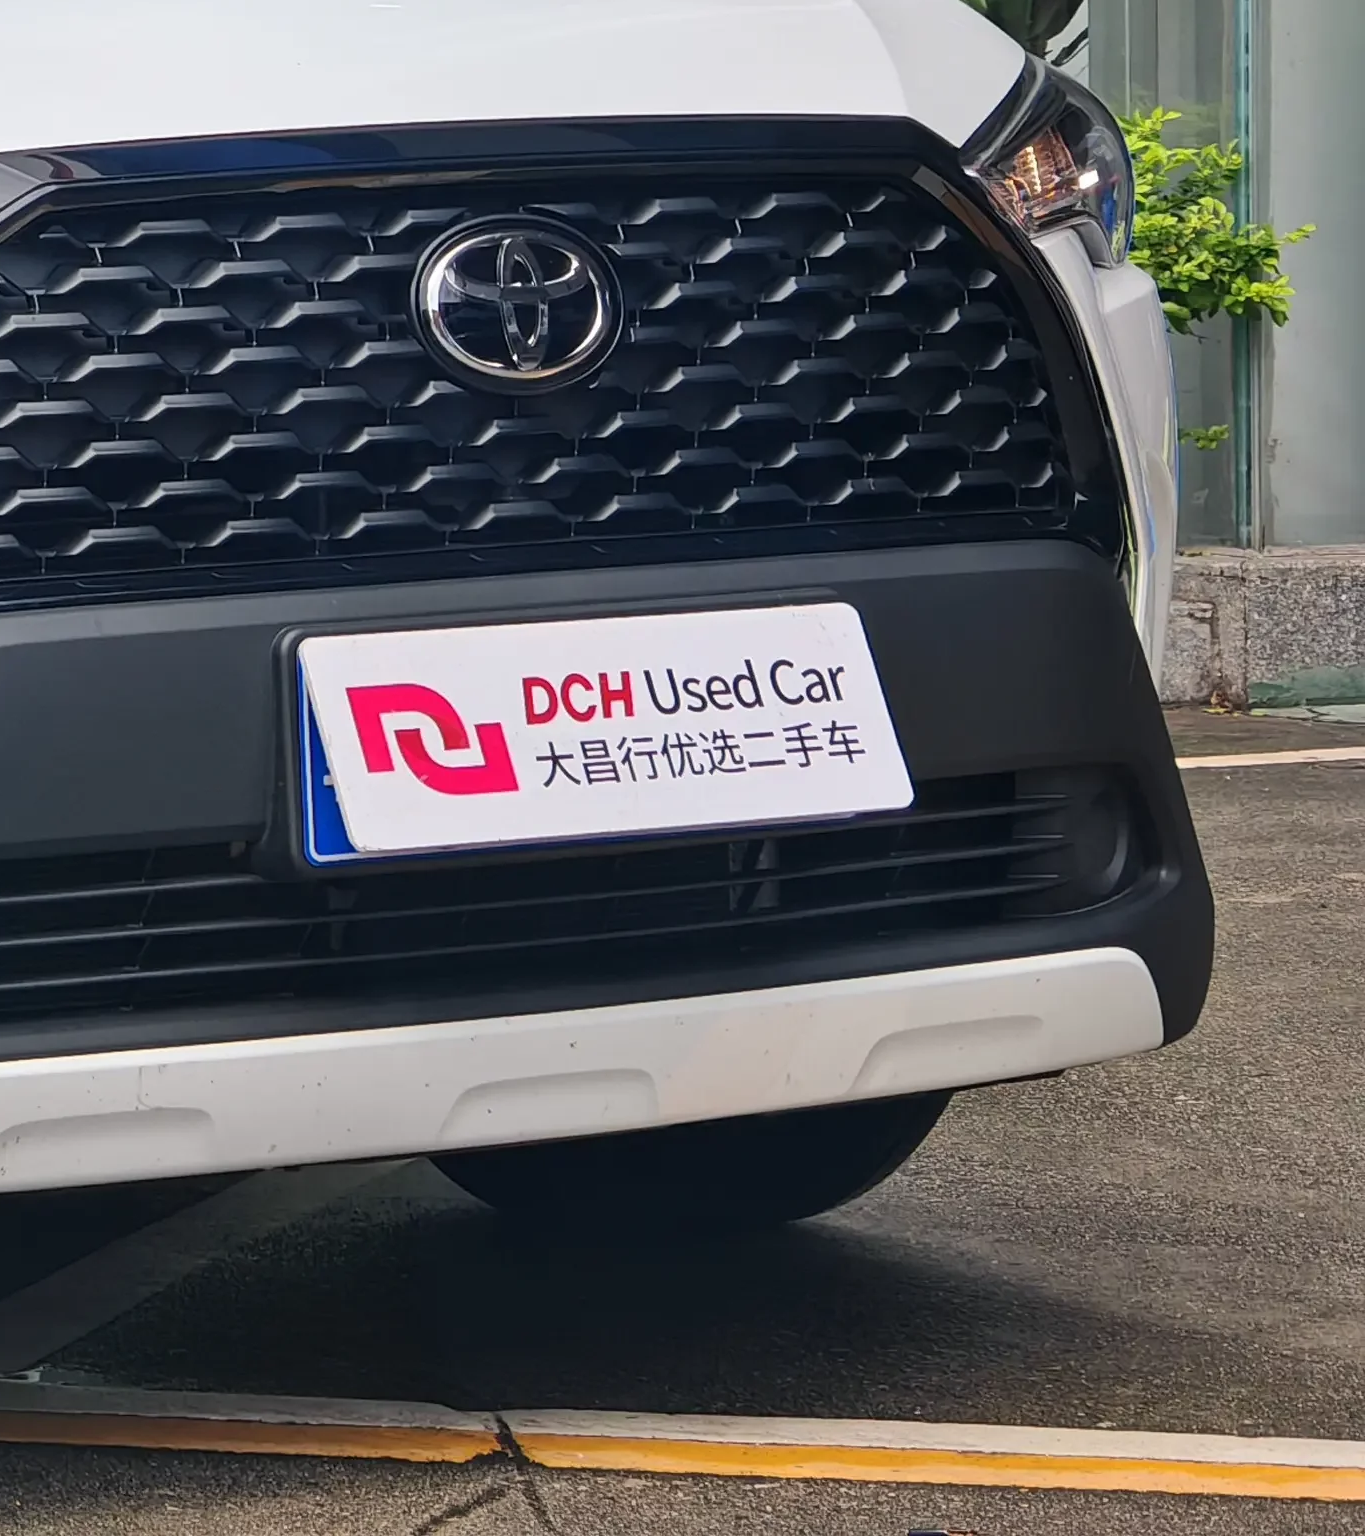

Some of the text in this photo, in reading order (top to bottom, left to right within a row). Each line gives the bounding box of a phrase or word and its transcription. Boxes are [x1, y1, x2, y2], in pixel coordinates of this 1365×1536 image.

[521, 659, 846, 726] DCH Used Car
[535, 720, 866, 789] 大昌行优选二手车
